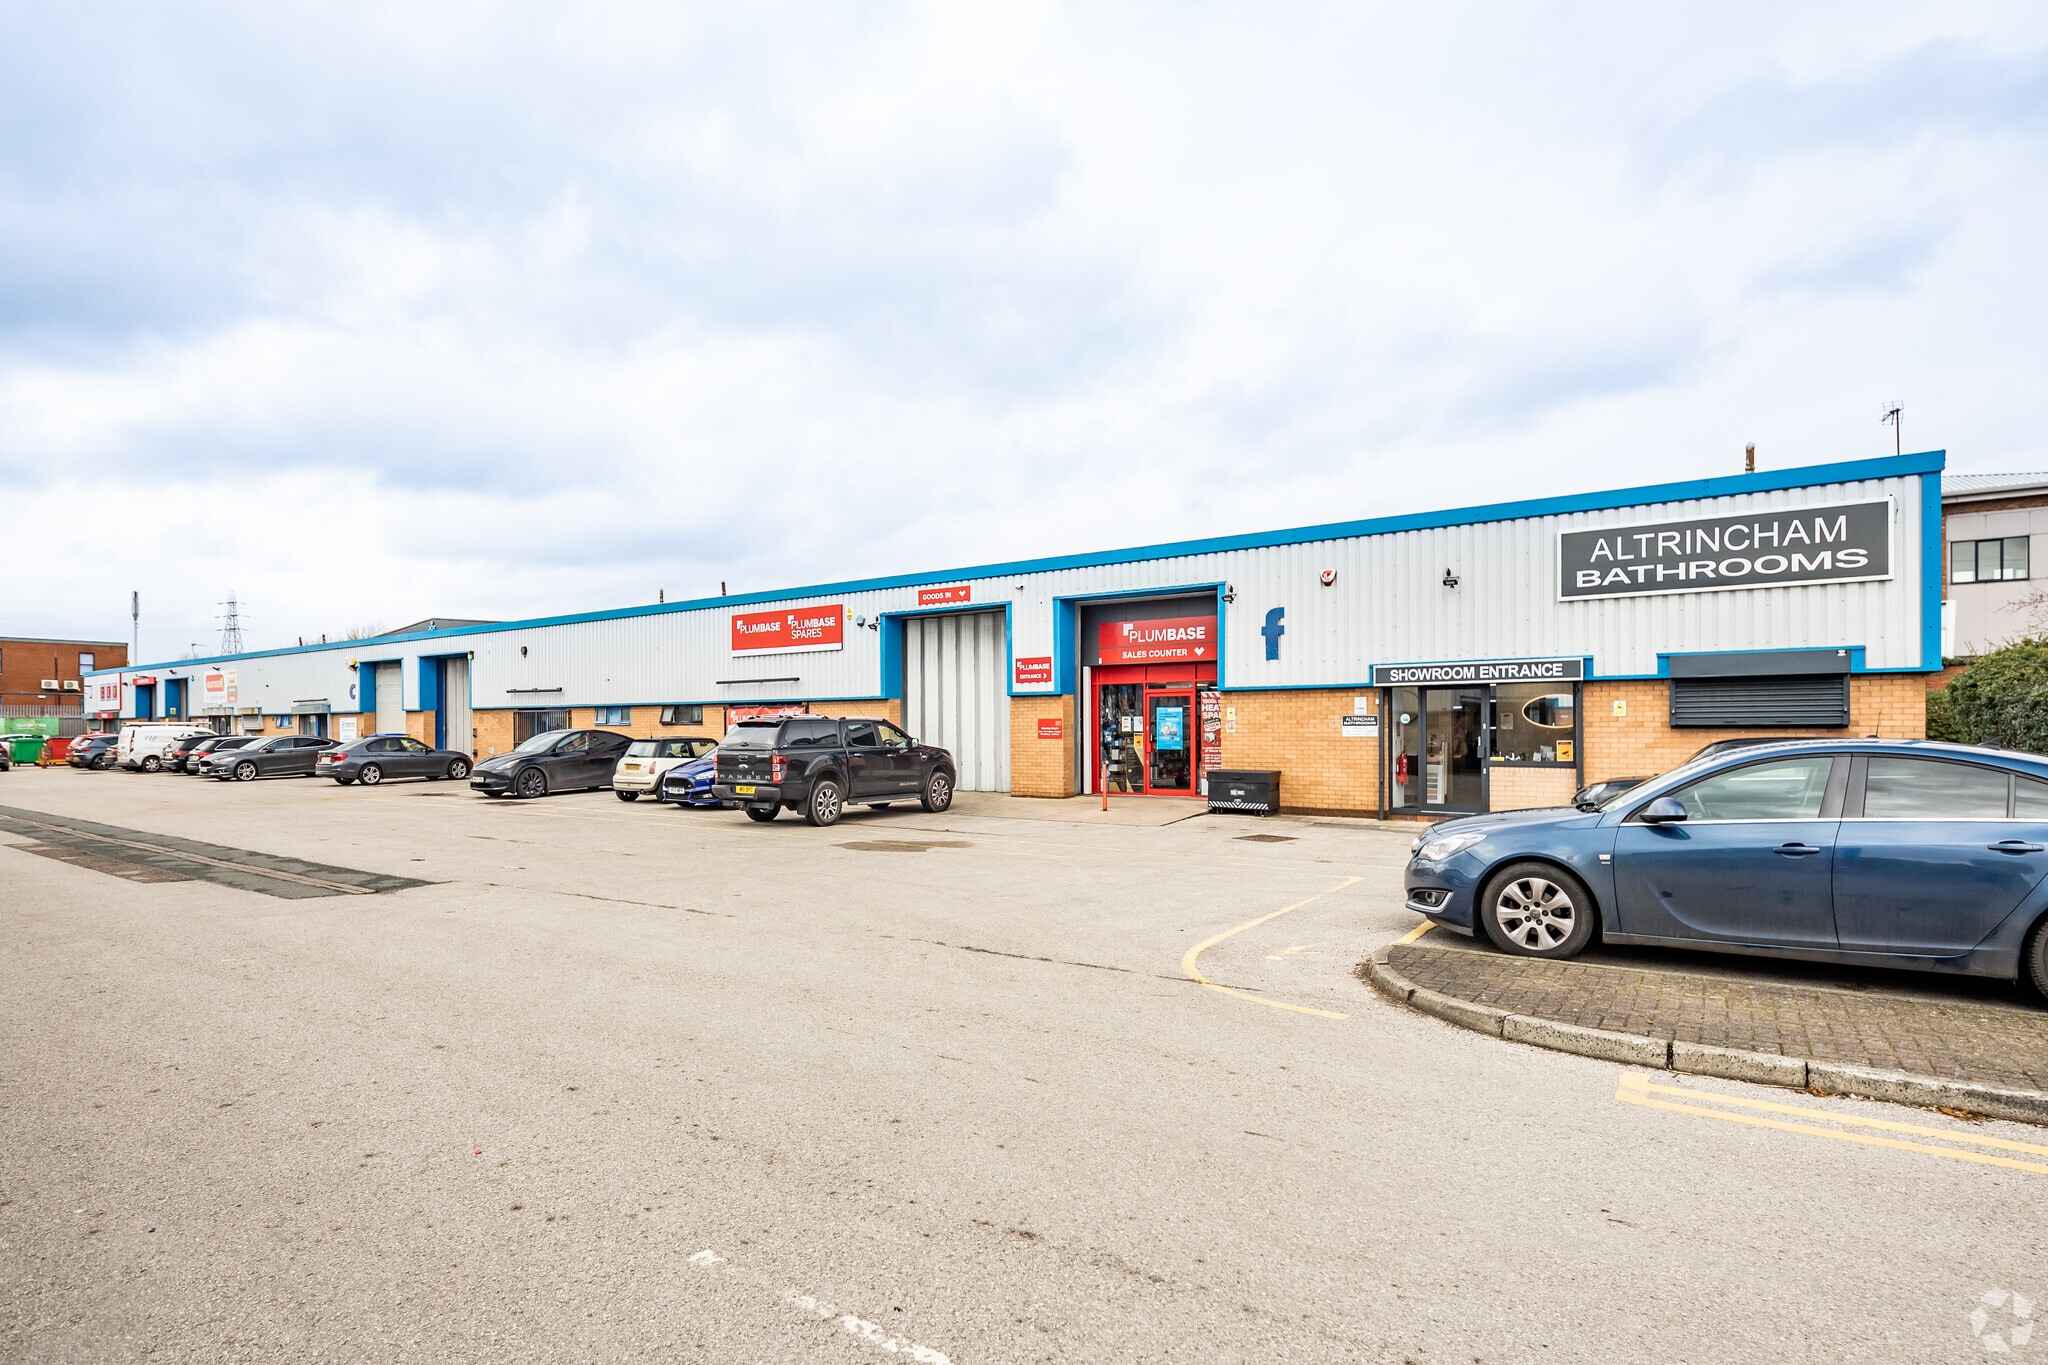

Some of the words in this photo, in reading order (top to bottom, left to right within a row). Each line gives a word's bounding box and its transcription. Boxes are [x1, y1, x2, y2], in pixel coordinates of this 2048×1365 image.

[1590, 515, 1846, 563] ALTRINCHAM
[1576, 548, 1869, 588] BATHROOMS
[922, 592, 944, 601] GOODS
[945, 591, 952, 599] IN
[740, 621, 781, 635] PLUMBASE
[791, 616, 836, 630] PLUMBASE
[791, 628, 822, 640] SPARES
[1130, 626, 1206, 644] PLUMBASE
[1122, 650, 1147, 659] SALES
[1148, 648, 1188, 658] COUNTER
[1019, 662, 1050, 671] PLUMBASE
[1389, 665, 1475, 682] SHOWROOM
[1480, 662, 1563, 679] ENTRANCE
[719, 773, 772, 781] RANGER
